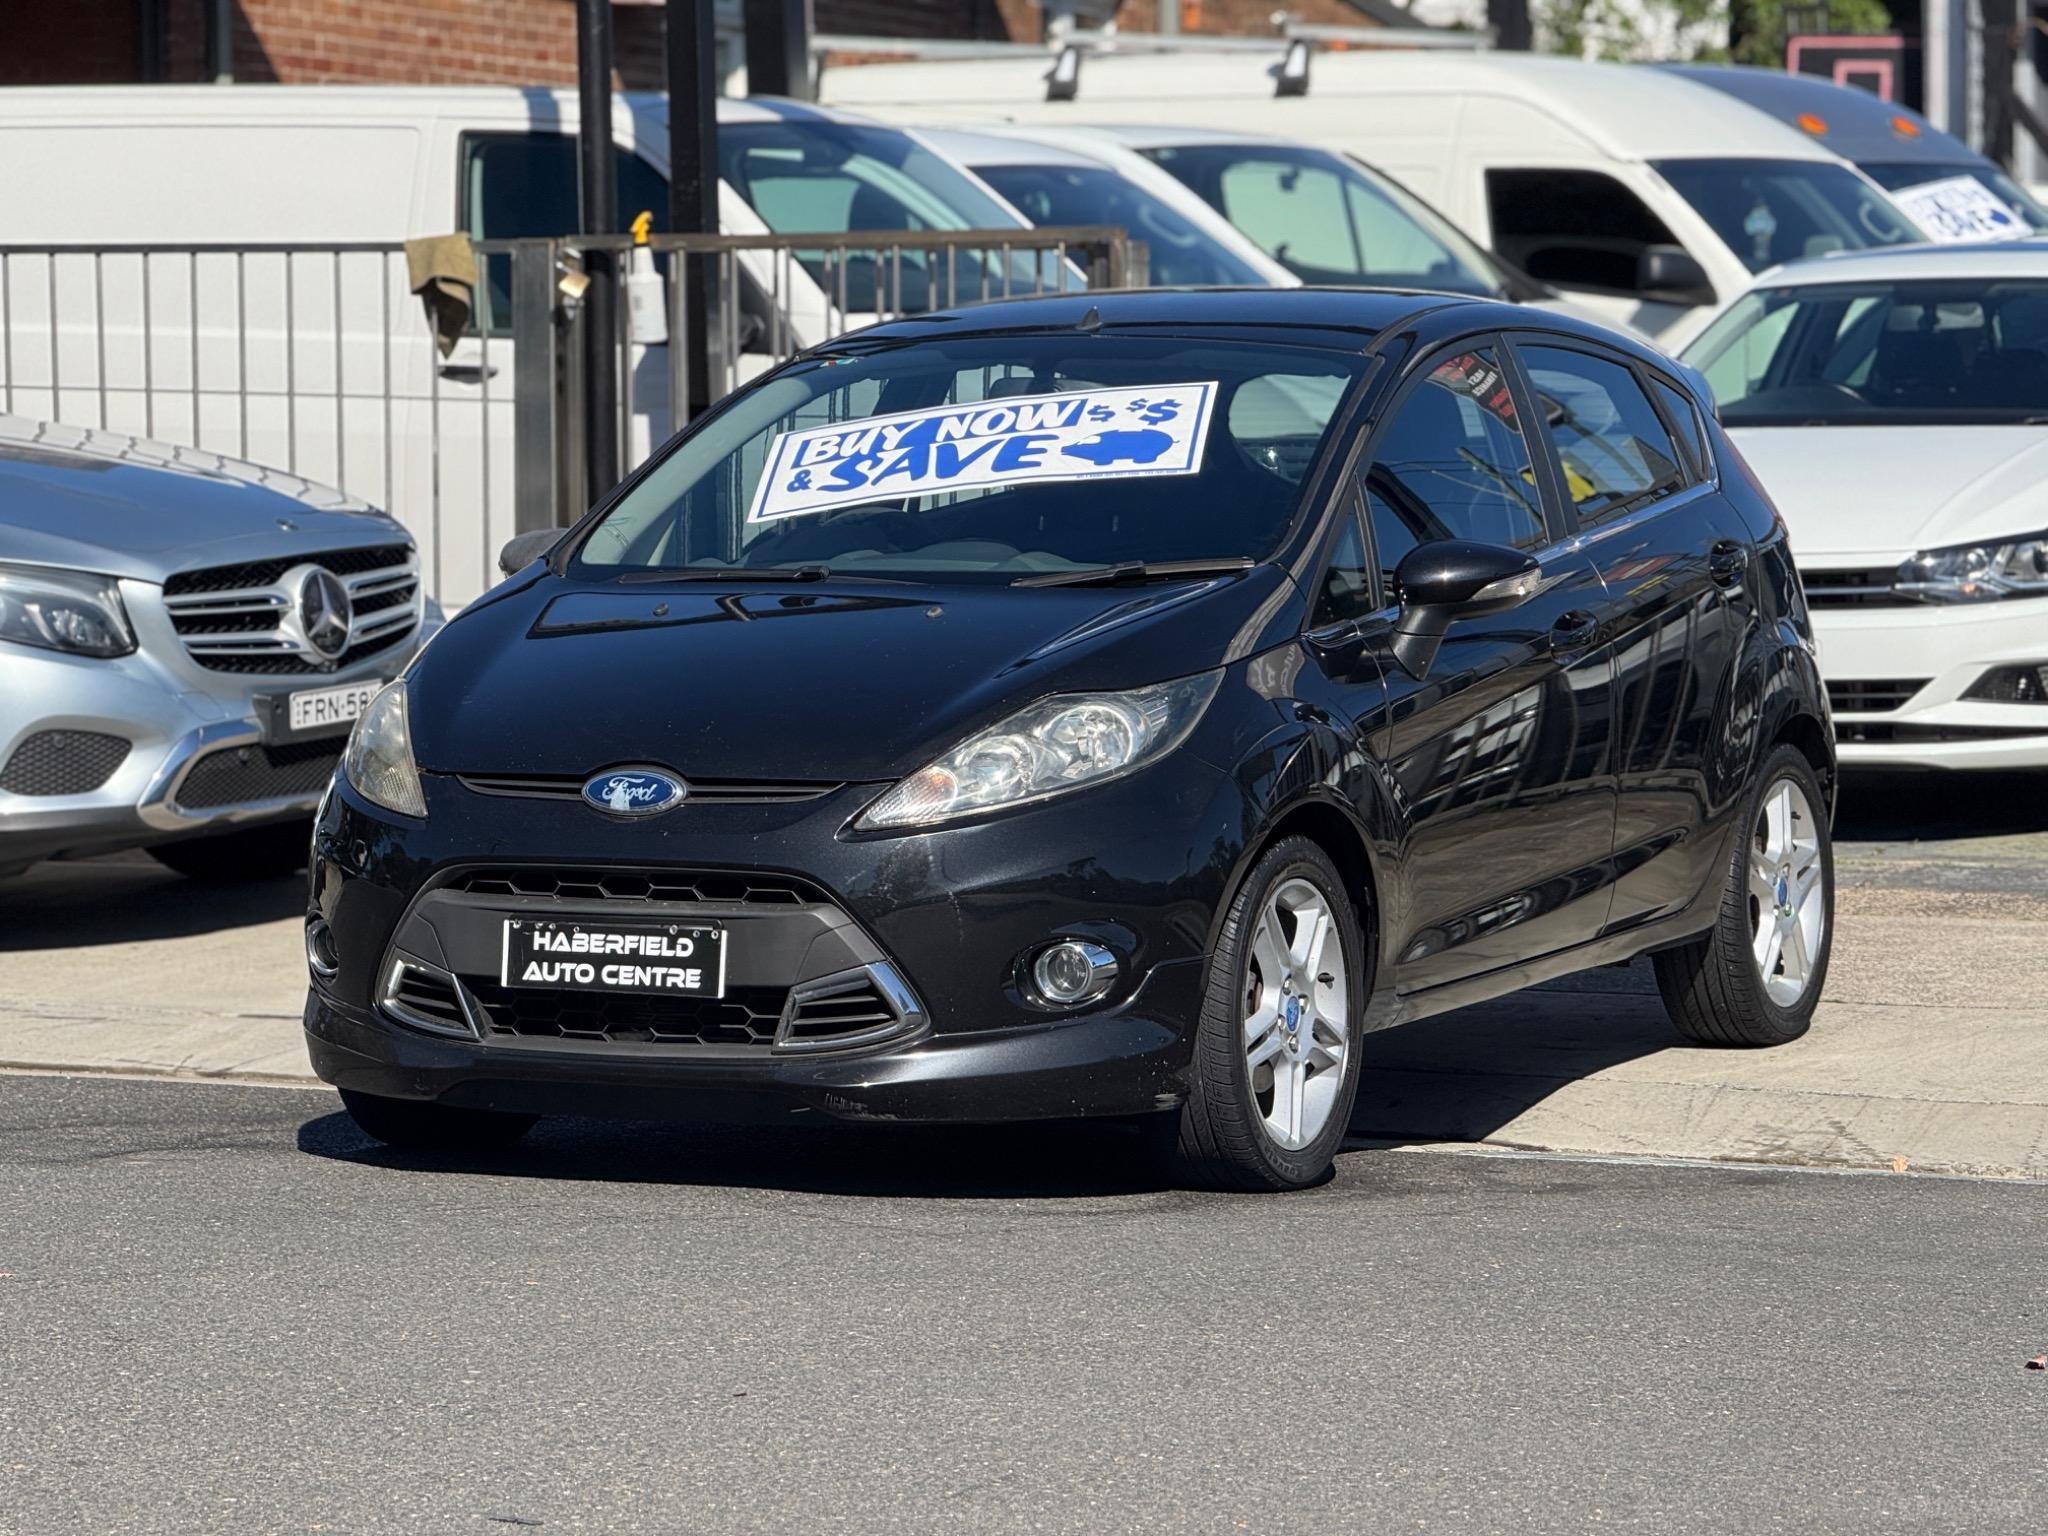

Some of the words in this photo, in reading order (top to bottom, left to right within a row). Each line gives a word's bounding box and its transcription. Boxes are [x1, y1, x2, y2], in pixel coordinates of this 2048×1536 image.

[800, 420, 925, 466] BUY
[935, 400, 1083, 443] NOW
[787, 469, 812, 492] &
[816, 434, 1060, 492] SAVE
[602, 776, 658, 801] Ford
[533, 931, 694, 958] HABERFIELD
[522, 961, 595, 983] AUTO
[601, 964, 702, 989] CENTRE
